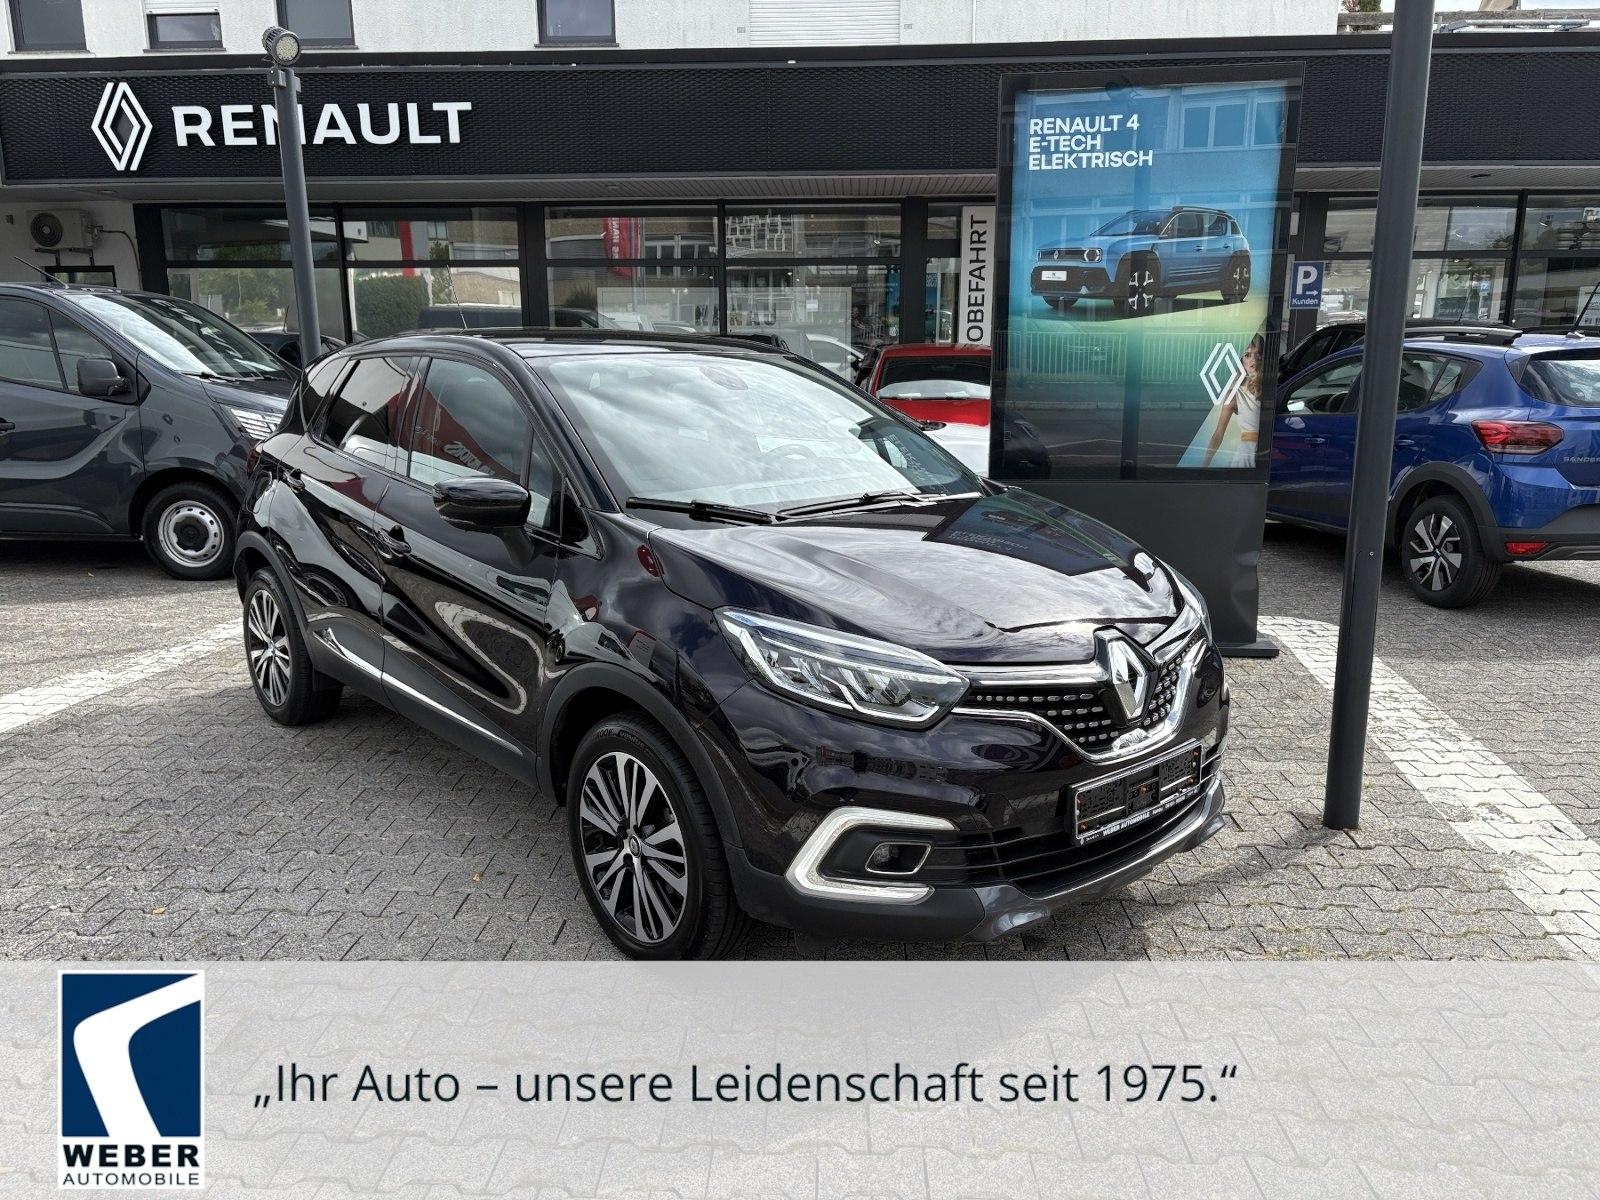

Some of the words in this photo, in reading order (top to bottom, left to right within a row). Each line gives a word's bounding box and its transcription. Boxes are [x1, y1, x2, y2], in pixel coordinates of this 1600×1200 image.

[171, 101, 472, 147] RENAULT
[1029, 114, 1123, 135] RENAULT
[1126, 113, 1140, 131] 4
[1029, 134, 1102, 153] E-TECH
[1028, 150, 1154, 171] ELEKTRISCH
[1296, 265, 1318, 295] P
[1292, 297, 1319, 305] Kunden
